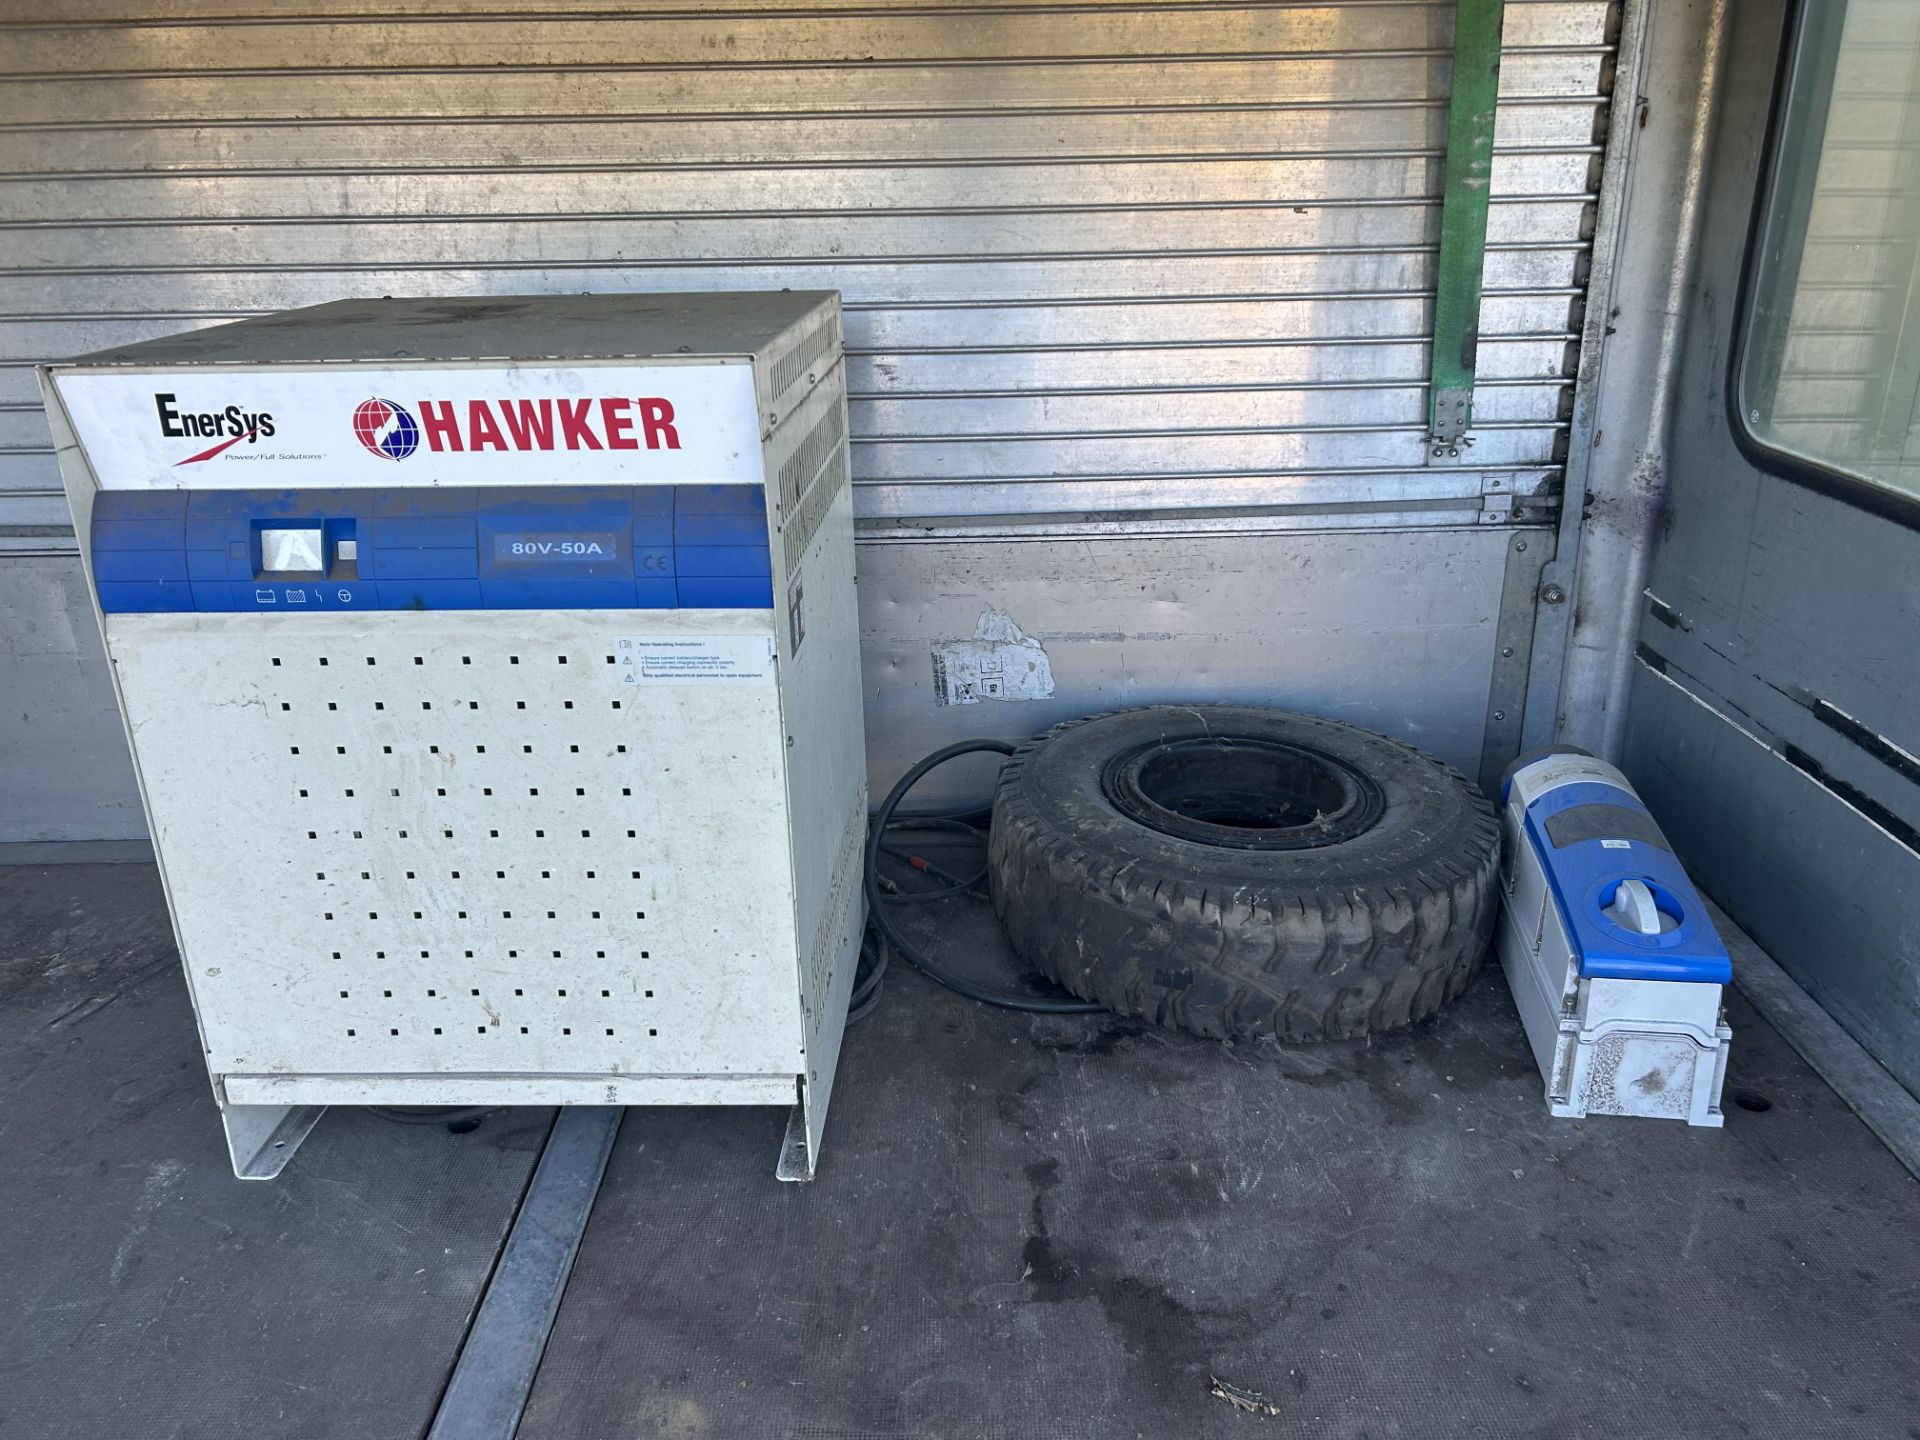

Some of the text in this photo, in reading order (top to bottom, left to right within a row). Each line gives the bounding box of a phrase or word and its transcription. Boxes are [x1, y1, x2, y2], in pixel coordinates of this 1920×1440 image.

[154, 393, 276, 444] EnerSys
[418, 397, 682, 452] HAWKER
[511, 542, 603, 555] 80V-50A
